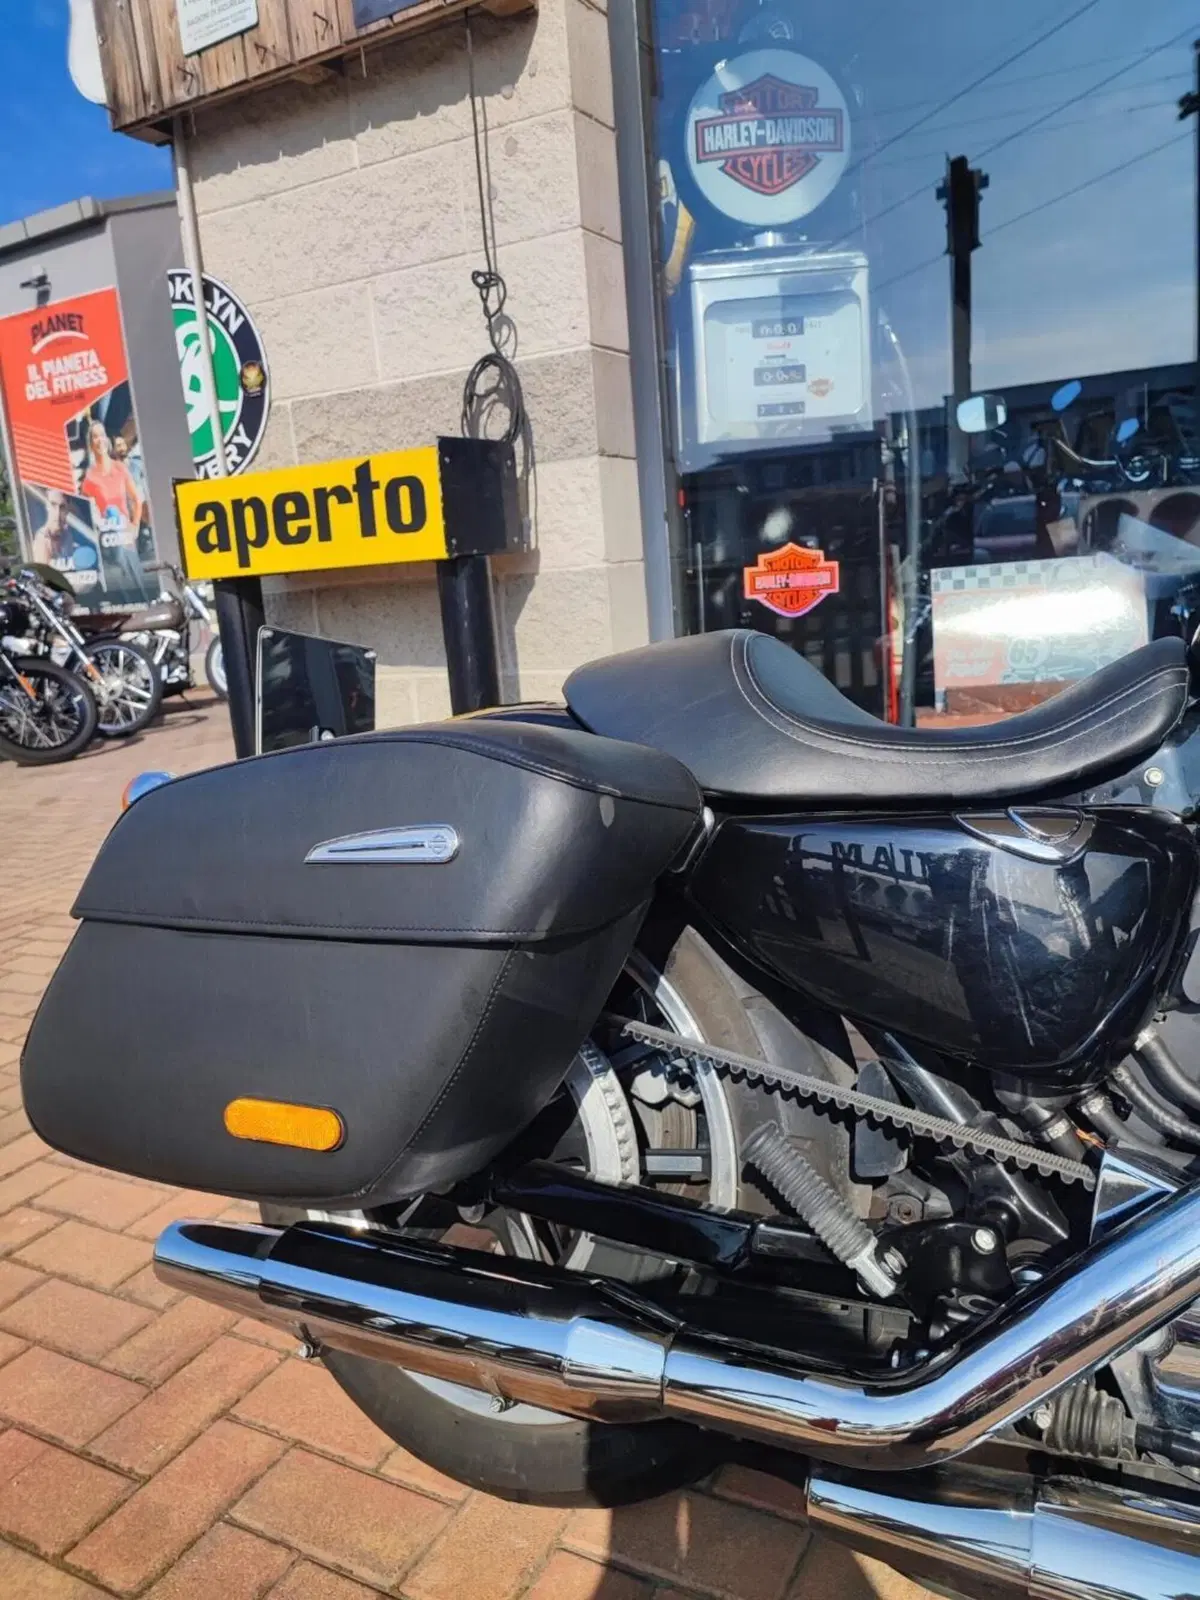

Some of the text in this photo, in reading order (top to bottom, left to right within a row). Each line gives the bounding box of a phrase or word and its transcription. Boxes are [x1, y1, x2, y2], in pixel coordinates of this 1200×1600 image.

[704, 117, 835, 152] HARLEY-DAVIDSON
[737, 152, 806, 187] CYCLES
[31, 312, 84, 346] PLANET
[27, 348, 100, 382] IL PIANETA
[26, 380, 53, 401] DEL
[53, 366, 108, 395] FITNESS
[194, 459, 427, 568] aperto
